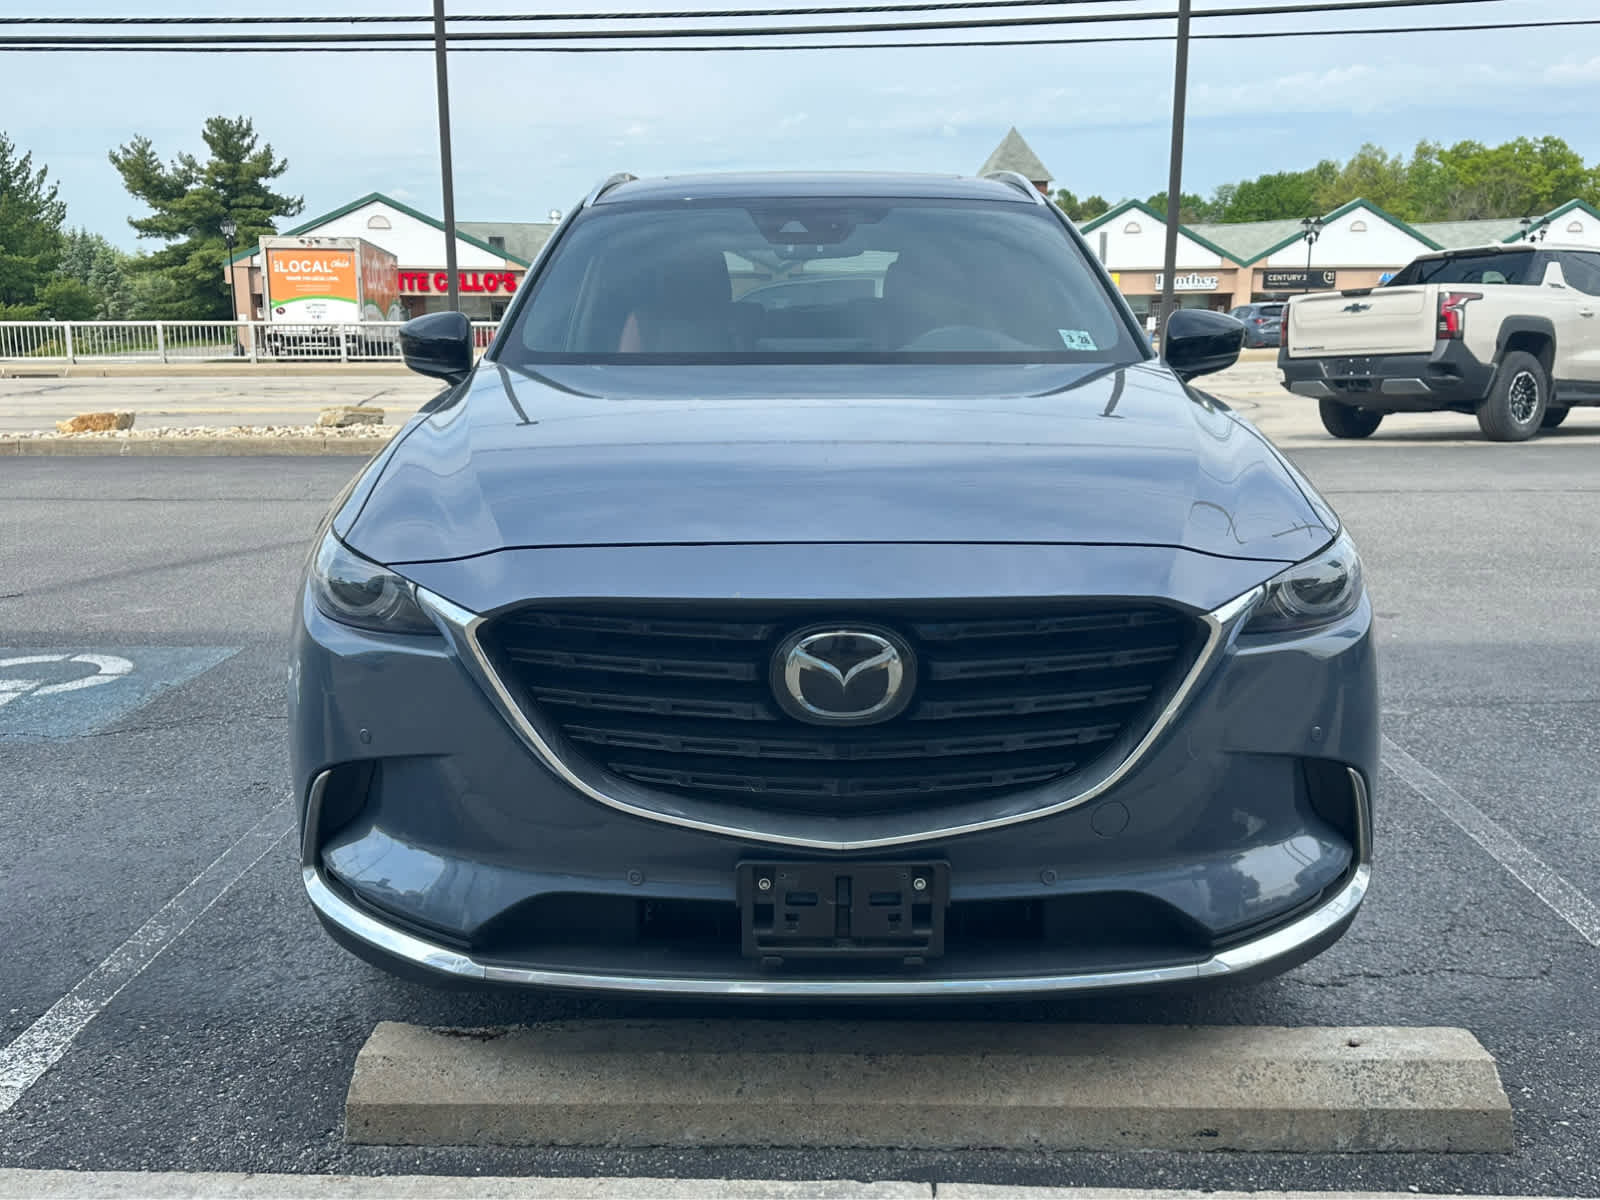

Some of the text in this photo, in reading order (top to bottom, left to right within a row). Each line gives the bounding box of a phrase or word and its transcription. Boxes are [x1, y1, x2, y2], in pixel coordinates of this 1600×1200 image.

[279, 259, 333, 273] LOCAL
[433, 272, 518, 293] CLLO'S
[1267, 273, 1301, 281] CENTURY
